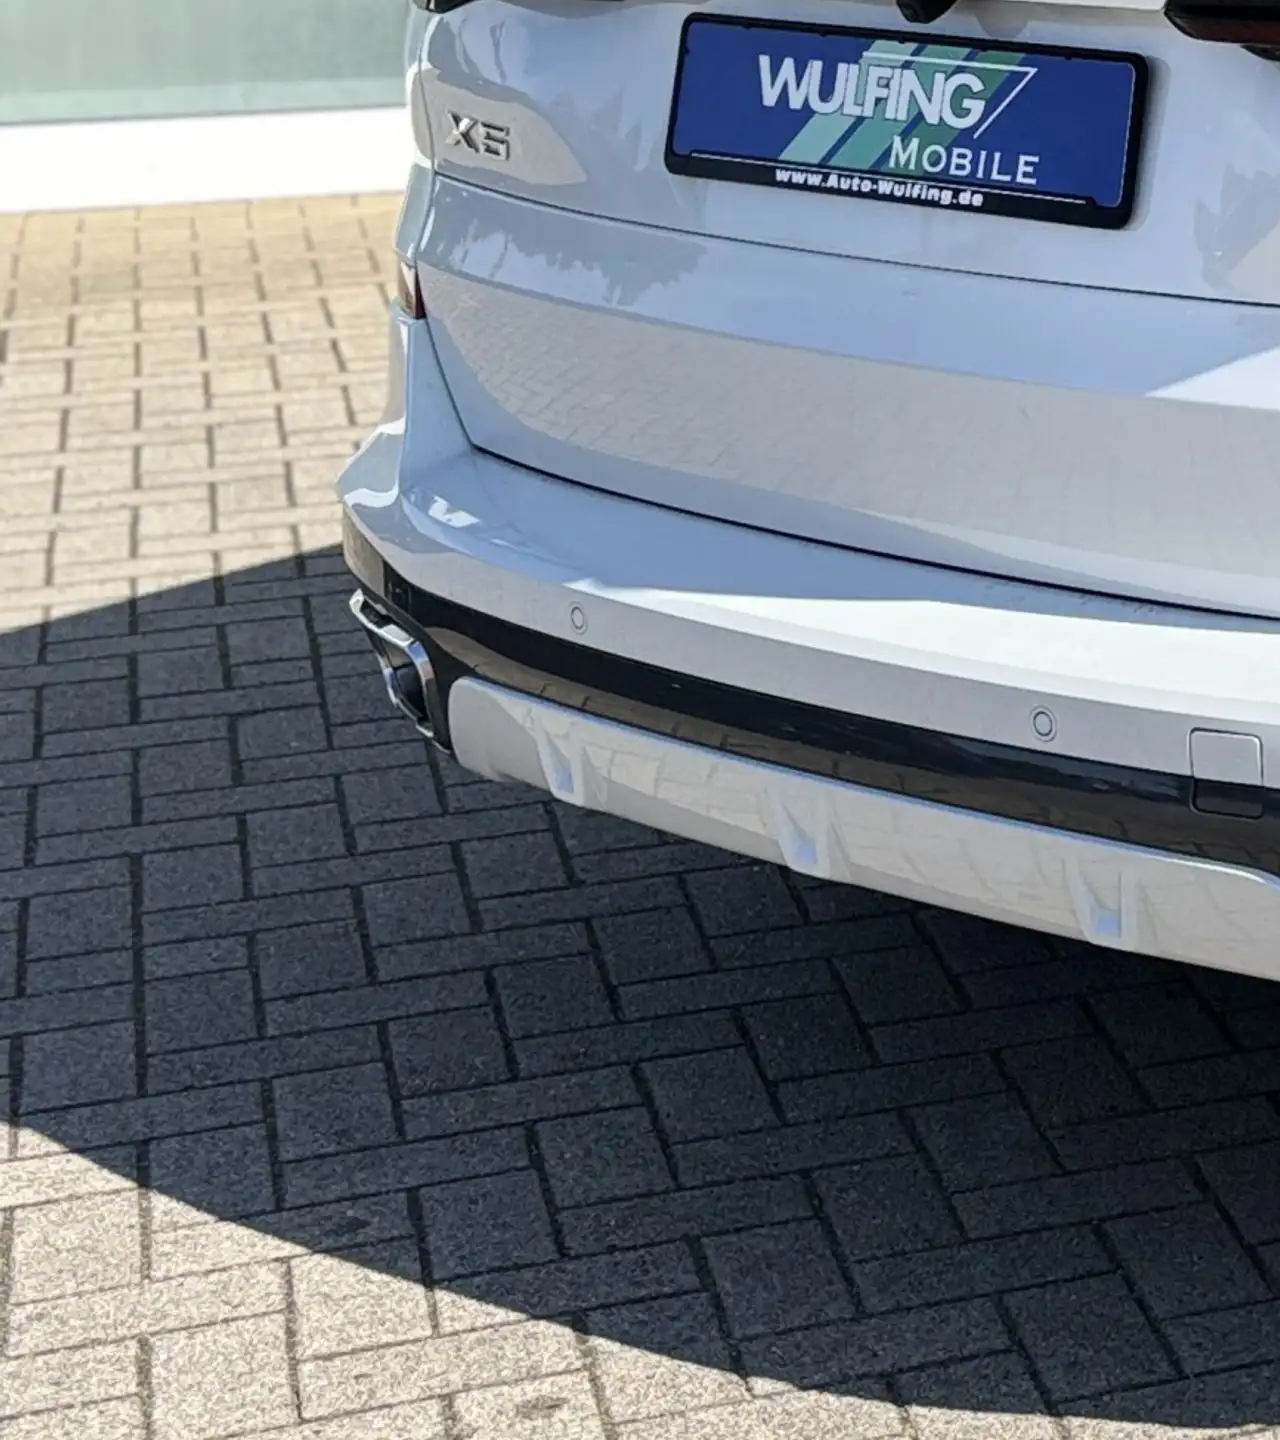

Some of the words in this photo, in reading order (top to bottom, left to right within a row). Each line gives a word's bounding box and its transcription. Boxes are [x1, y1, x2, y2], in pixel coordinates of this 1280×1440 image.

[758, 54, 986, 129] WULFING
[444, 109, 511, 161] X5
[889, 135, 1040, 185] MOBILE
[774, 168, 985, 207] www.Auto-Wulfing.de
